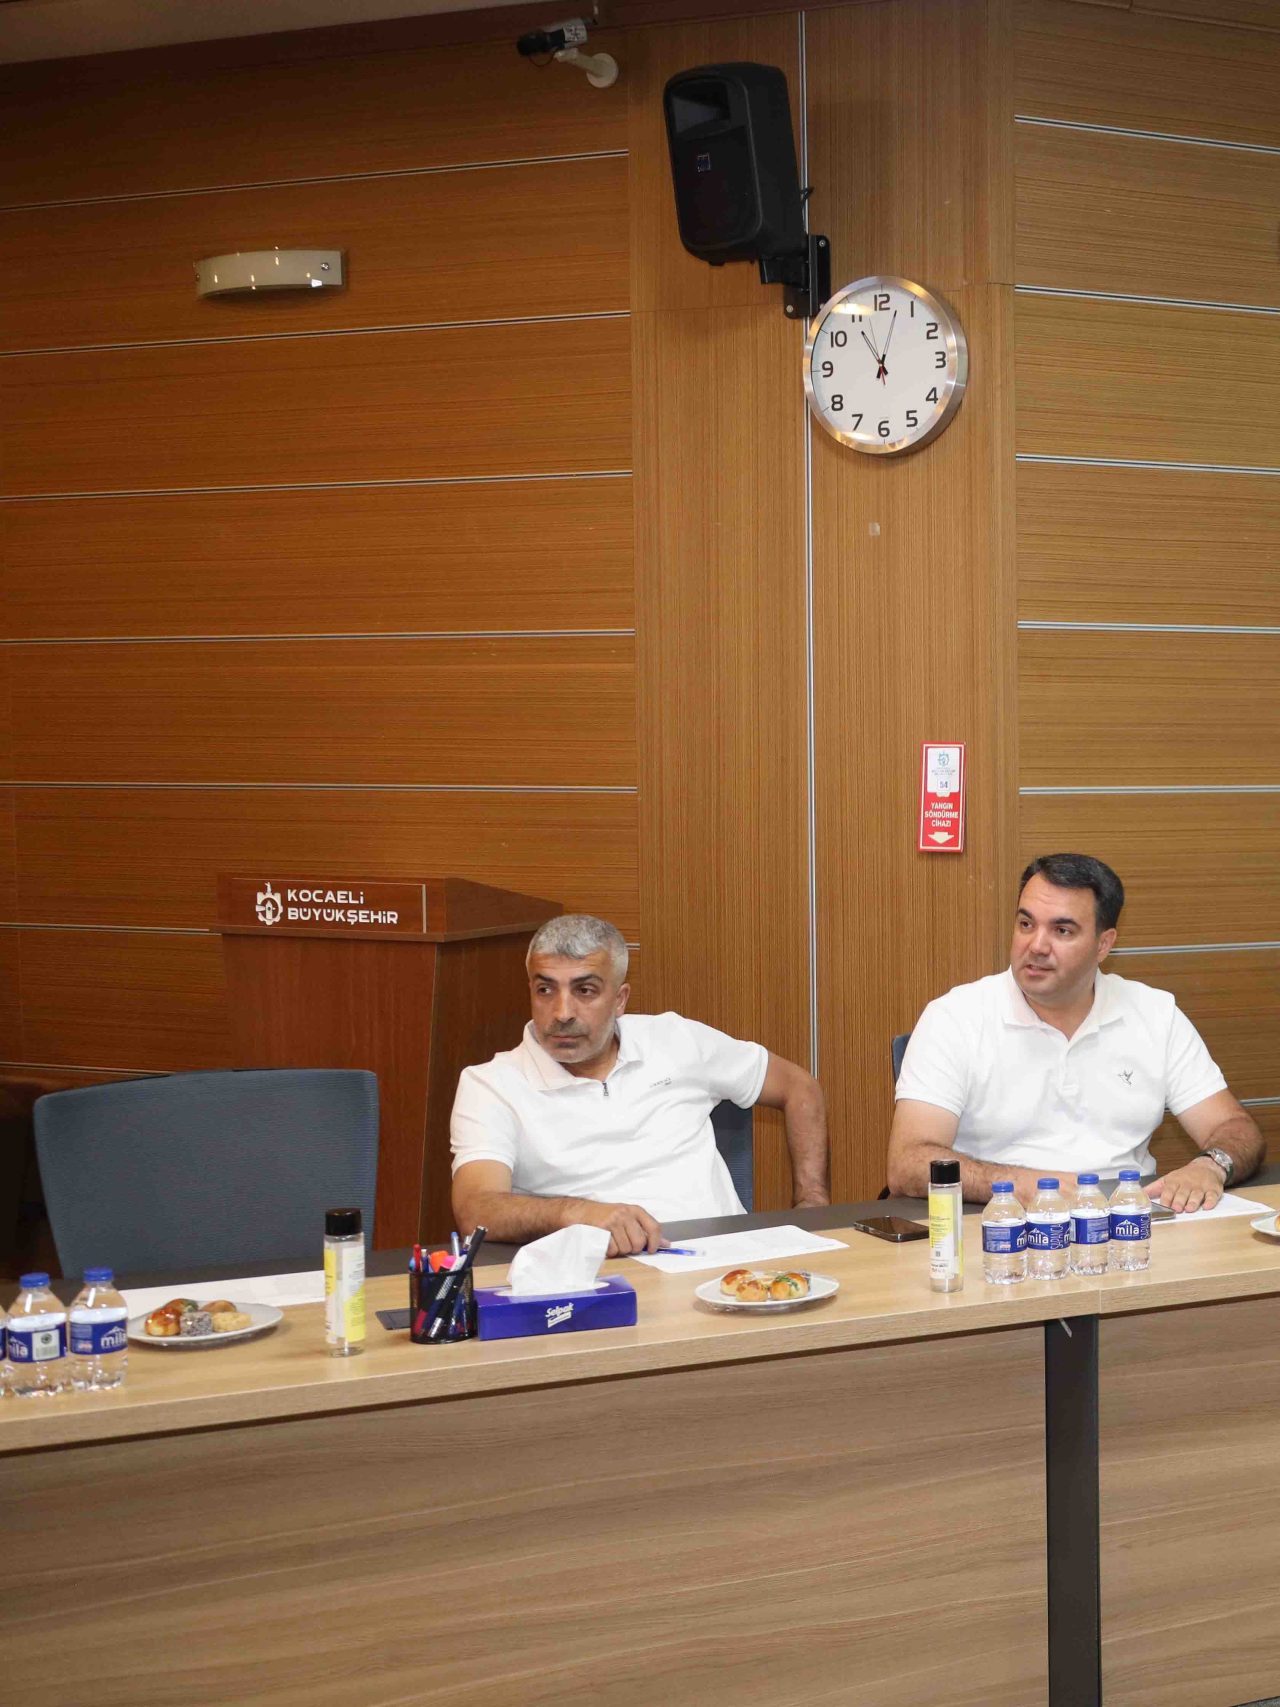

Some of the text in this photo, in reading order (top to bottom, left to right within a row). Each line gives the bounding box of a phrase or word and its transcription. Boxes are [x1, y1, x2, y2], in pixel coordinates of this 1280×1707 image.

[874, 293, 890, 311] 12
[911, 300, 914, 317] 1
[830, 330, 847, 348] 10
[926, 322, 938, 339] 2
[935, 351, 946, 368] 3
[821, 361, 833, 378] 9
[831, 394, 844, 411] 8
[925, 387, 938, 404] 4
[851, 414, 863, 431] 7
[906, 410, 918, 427] 5
[878, 420, 890, 437] 6
[925, 809, 958, 818] SÖNDÜRME
[931, 802, 954, 810] YANGIN
[931, 818, 952, 827] CİHAZI
[287, 888, 364, 905] KOCAELİ
[287, 907, 399, 926] BÜYÜKŞEHİR
[1028, 1233, 1048, 1244] mila
[1116, 1225, 1140, 1235] mila
[545, 1302, 574, 1317] Selpak
